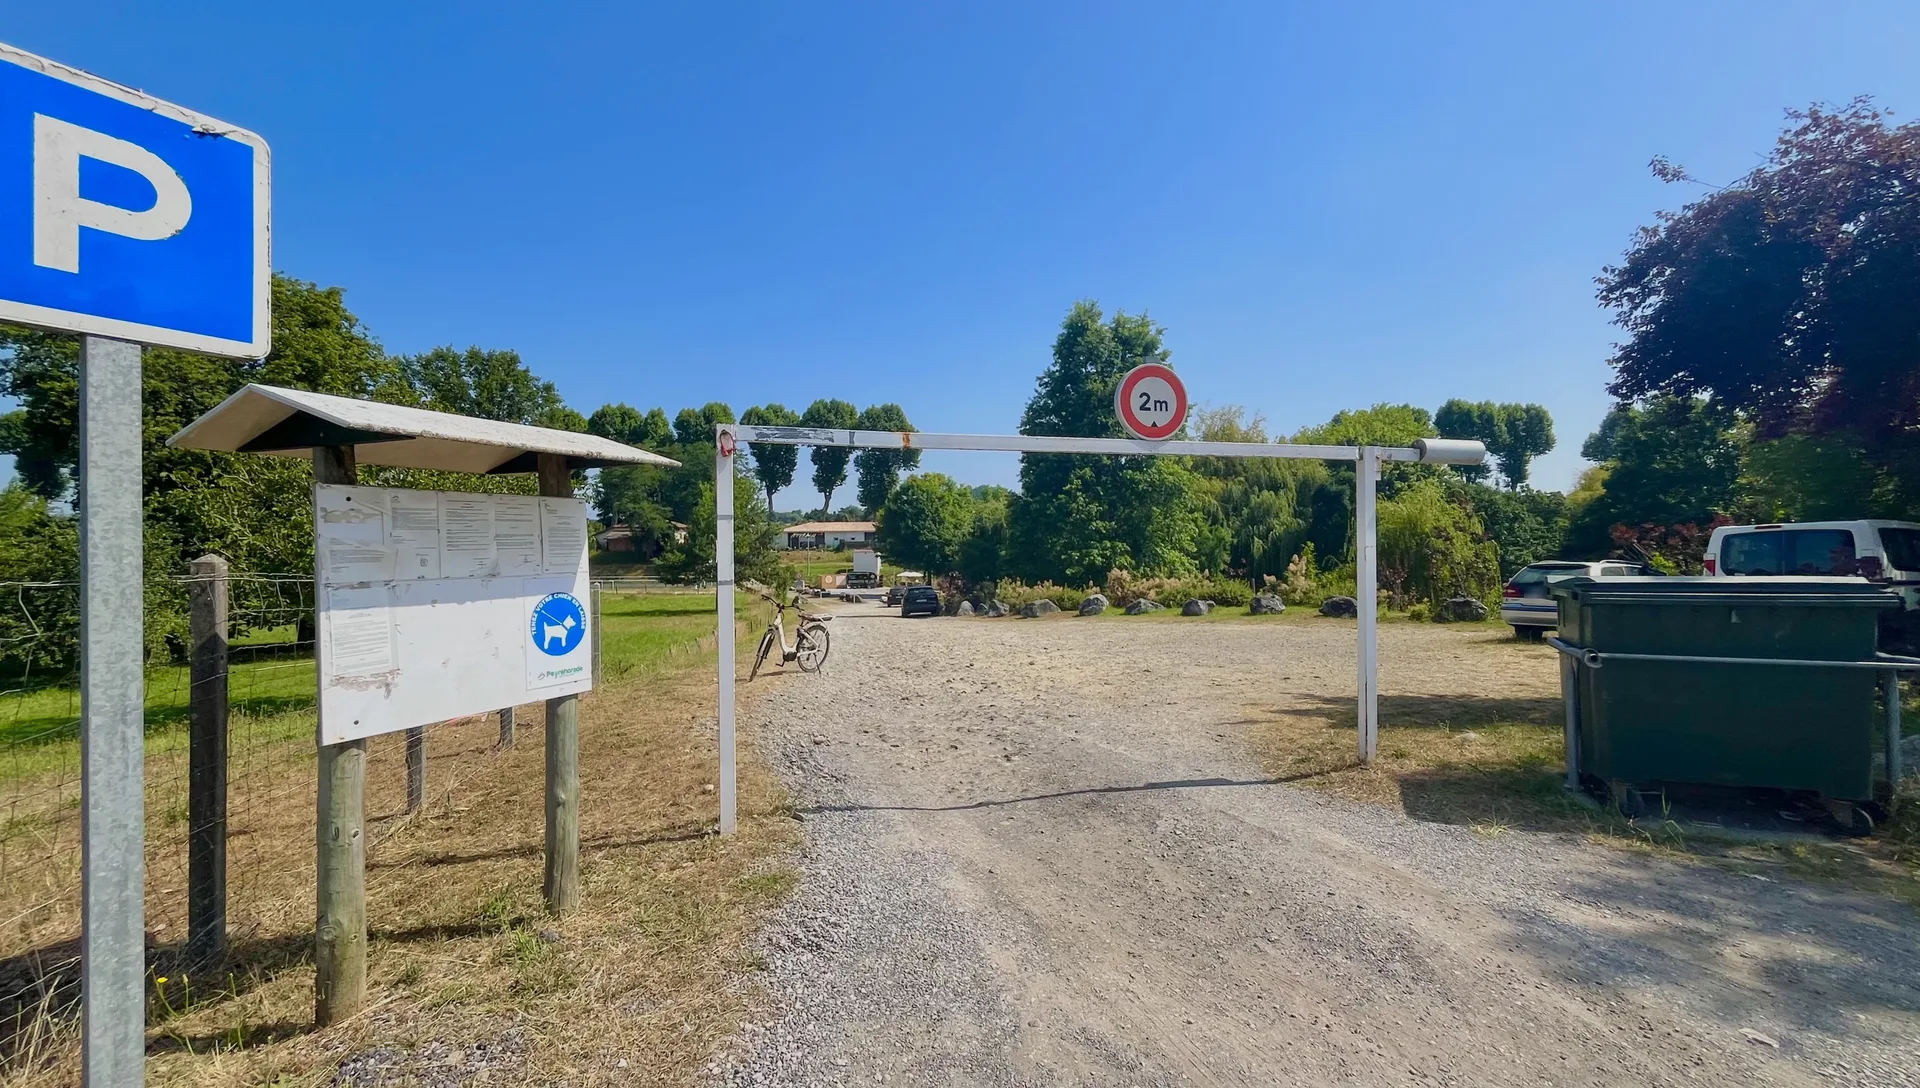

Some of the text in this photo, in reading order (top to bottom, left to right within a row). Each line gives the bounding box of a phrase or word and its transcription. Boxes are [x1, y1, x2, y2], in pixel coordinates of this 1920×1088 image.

[33, 111, 192, 274] P
[1139, 392, 1169, 412] 2m
[535, 595, 553, 611] VOTRE
[553, 593, 572, 601] CHIEN
